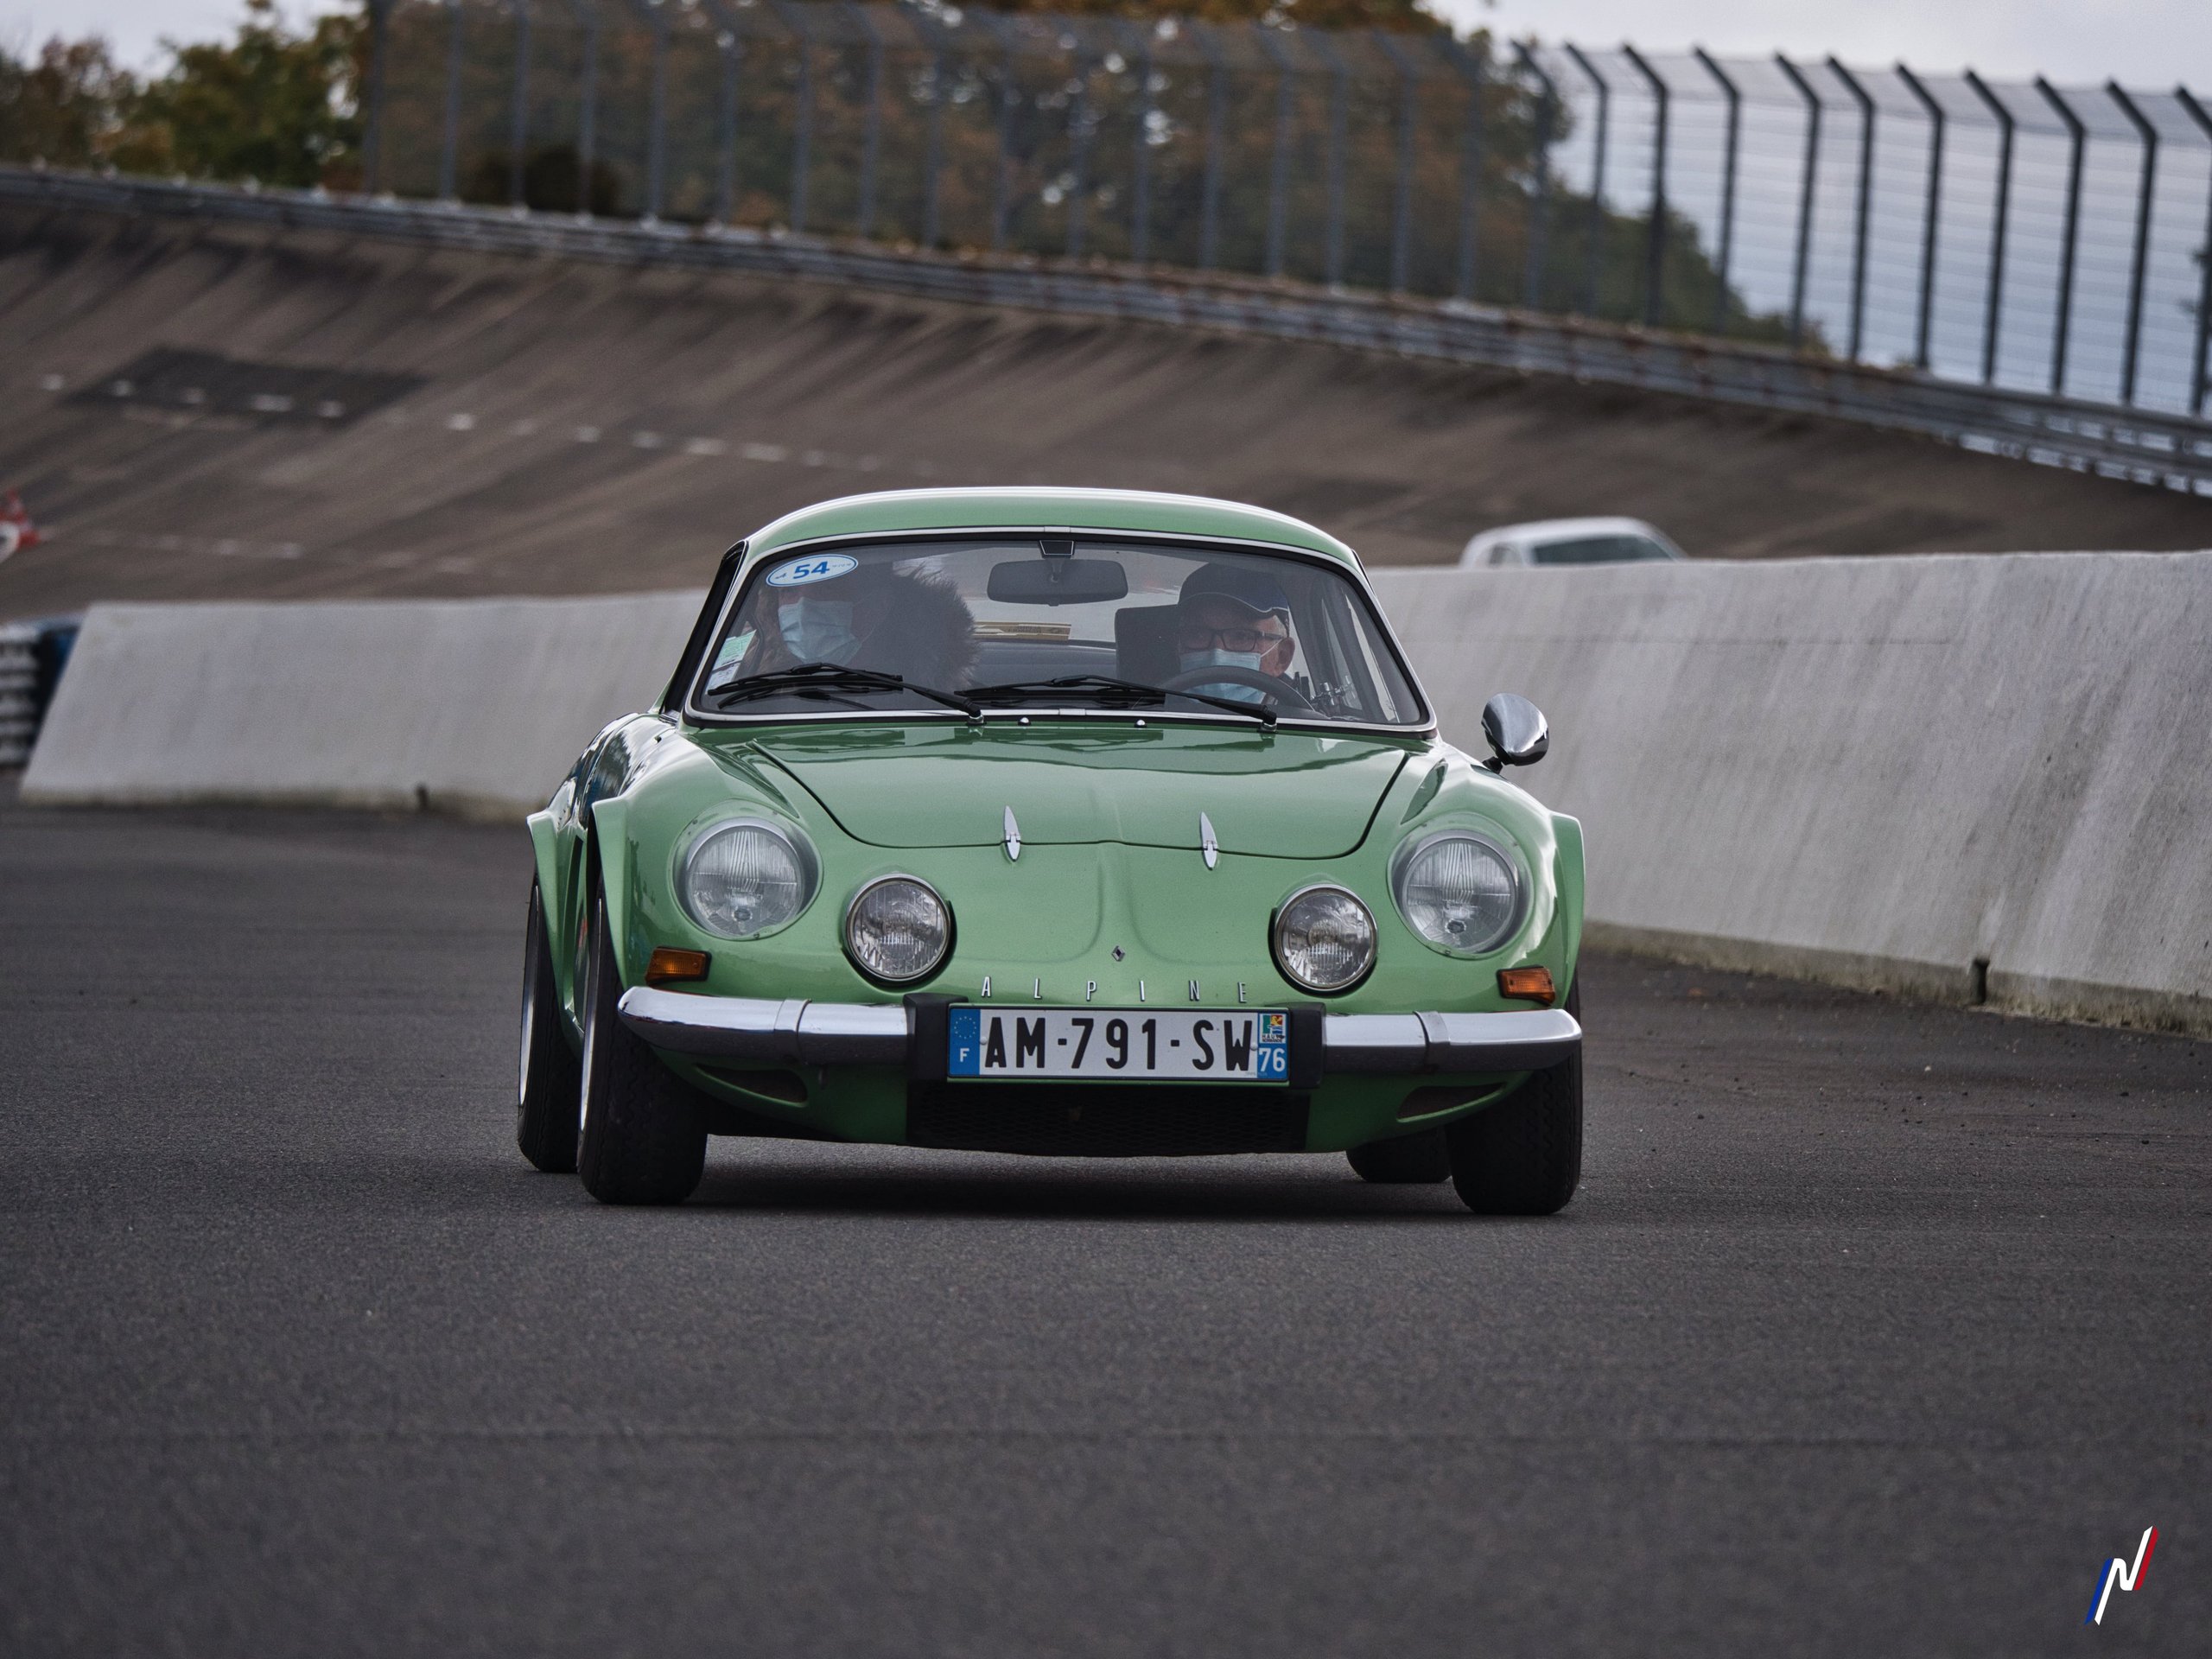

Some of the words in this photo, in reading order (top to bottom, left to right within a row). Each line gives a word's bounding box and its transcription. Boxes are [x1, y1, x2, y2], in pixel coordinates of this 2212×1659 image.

[792, 561, 830, 579] 54
[984, 1017, 1252, 1071] AM-791-SW
[959, 1048, 969, 1062] F
[1258, 1047, 1286, 1072] 76
